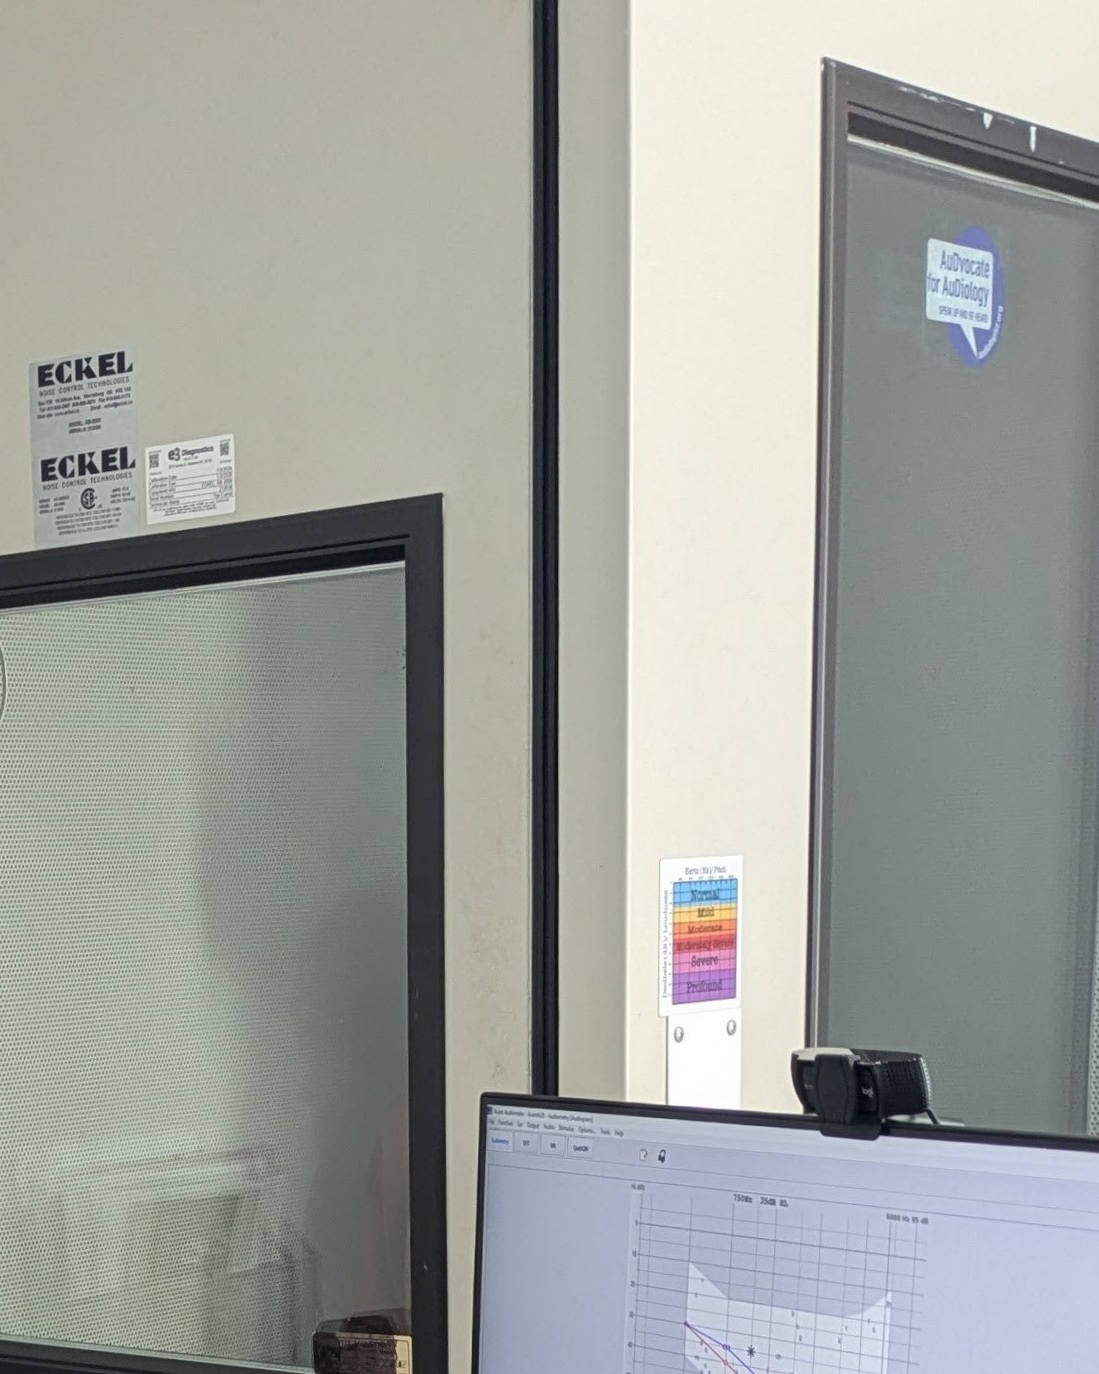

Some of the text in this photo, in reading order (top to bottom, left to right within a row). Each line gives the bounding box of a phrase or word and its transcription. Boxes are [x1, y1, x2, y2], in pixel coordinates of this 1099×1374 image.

[940, 250, 990, 278] AuDvocate
[927, 273, 989, 307] for AuDiology
[37, 351, 133, 388] ECKEL
[59, 384, 83, 394] CONTROL
[87, 376, 130, 389] TECHNOLOGIES
[41, 446, 136, 482] ECKEL
[91, 472, 132, 483] TECHNOLOGIES
[690, 888, 720, 901] Normal
[697, 907, 715, 917] Mild
[687, 924, 723, 934] Moderate
[691, 956, 718, 968] Severe
[686, 979, 722, 994] Profound
[733, 1193, 753, 1204] 750Hz
